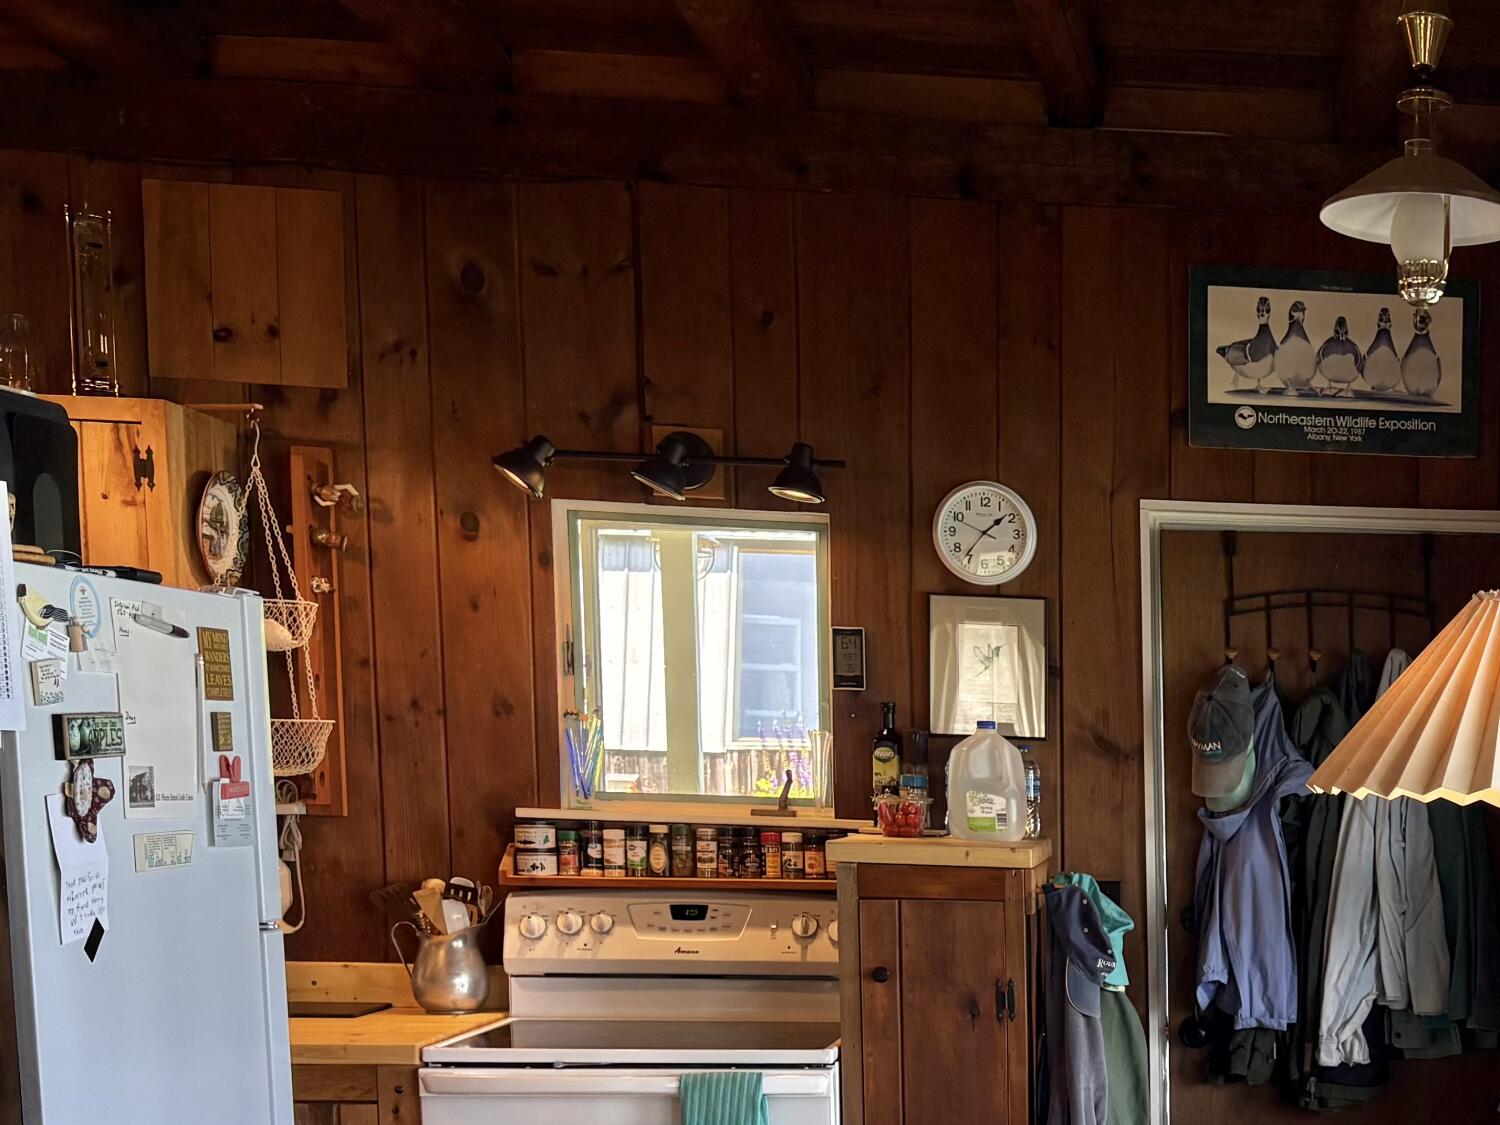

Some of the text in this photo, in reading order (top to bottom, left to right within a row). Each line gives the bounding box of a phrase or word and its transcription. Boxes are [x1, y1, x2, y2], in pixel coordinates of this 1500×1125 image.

[1258, 411, 1436, 431] Northeastern Wildlife Exposition
[1327, 426, 1349, 435] 20-22,
[1350, 427, 1366, 435] 1987
[1307, 433, 1331, 441] Albany,
[965, 500, 971, 511] 11
[980, 496, 991, 508] 12
[953, 511, 964, 522] 10
[1007, 513, 1016, 523] 2
[948, 526, 956, 536] 9
[1012, 529, 1021, 539] 3
[953, 542, 961, 553] 8
[1008, 544, 1016, 554] 4
[980, 559, 988, 569] 6
[996, 555, 1004, 566] 5
[206, 673, 231, 687] LEAVES
[88, 727, 123, 747] APPLES
[674, 946, 699, 954] Amana
